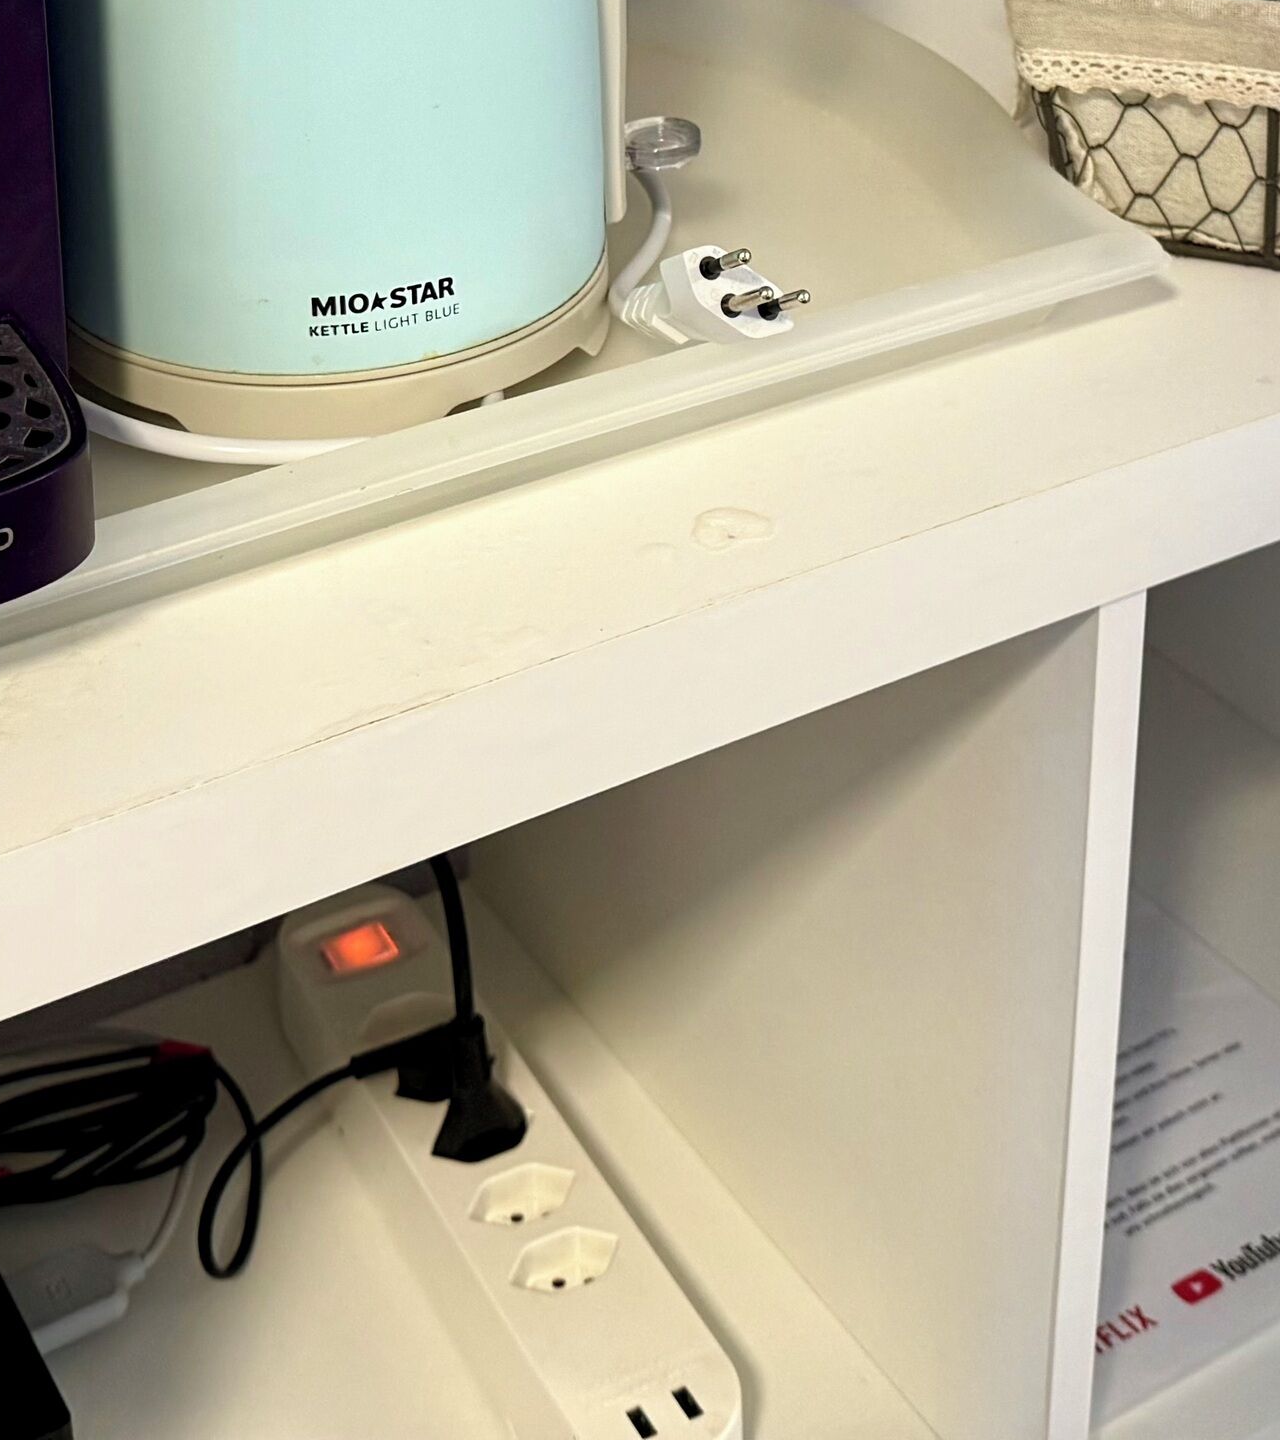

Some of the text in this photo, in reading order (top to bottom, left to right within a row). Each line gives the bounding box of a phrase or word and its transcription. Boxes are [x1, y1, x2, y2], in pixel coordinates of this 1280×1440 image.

[309, 302, 461, 338] KETTLE LIGHT BLUE
